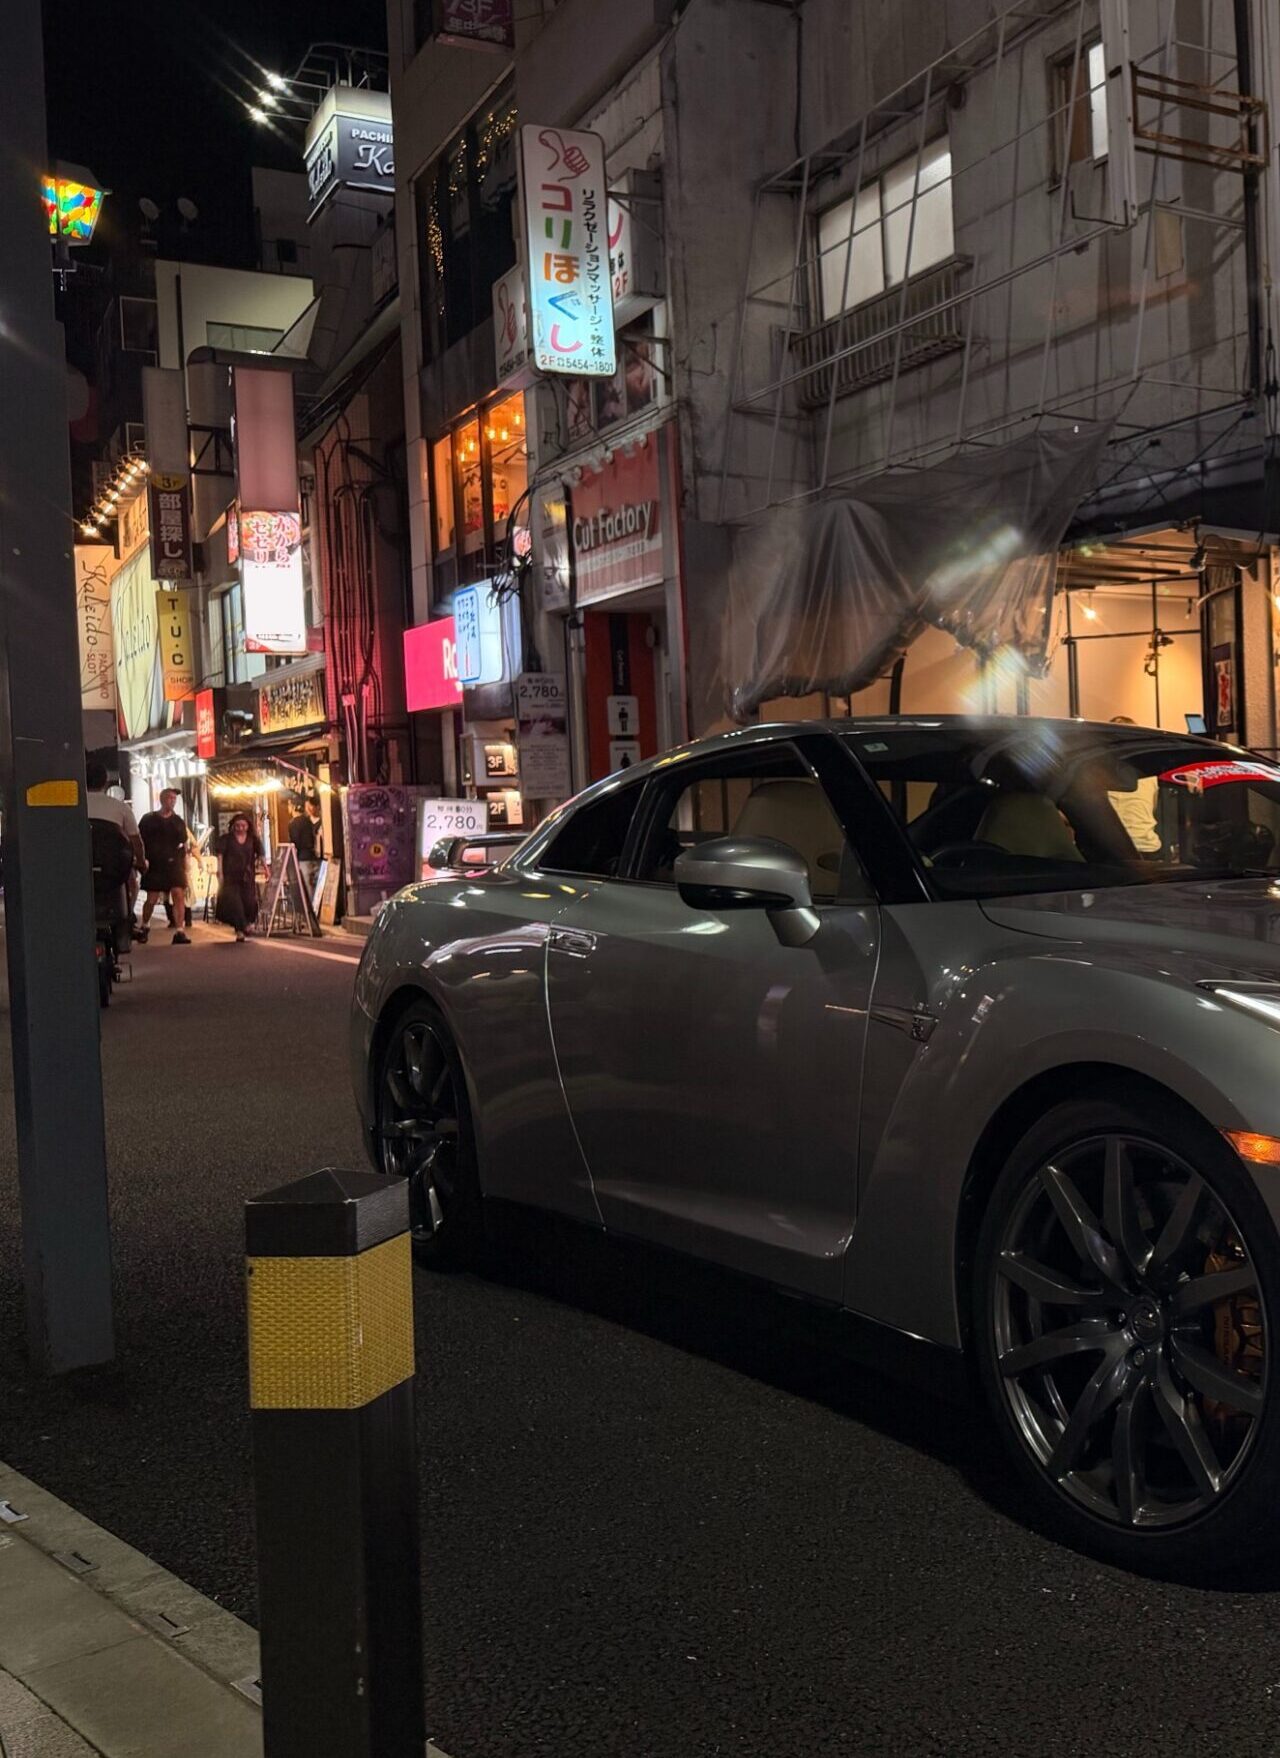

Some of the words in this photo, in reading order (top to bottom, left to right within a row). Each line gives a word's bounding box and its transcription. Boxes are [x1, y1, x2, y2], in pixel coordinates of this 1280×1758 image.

[541, 183, 583, 353] コリほぐし
[565, 357, 614, 373] 5454-1801
[573, 517, 595, 551] Cut
[598, 501, 652, 542] Factory
[82, 560, 109, 647] Kaleido
[87, 649, 97, 675] SLOT
[520, 685, 559, 699] 2,780
[487, 755, 503, 769] 3F
[489, 802, 505, 815] 2F
[427, 814, 476, 831] 2,780
